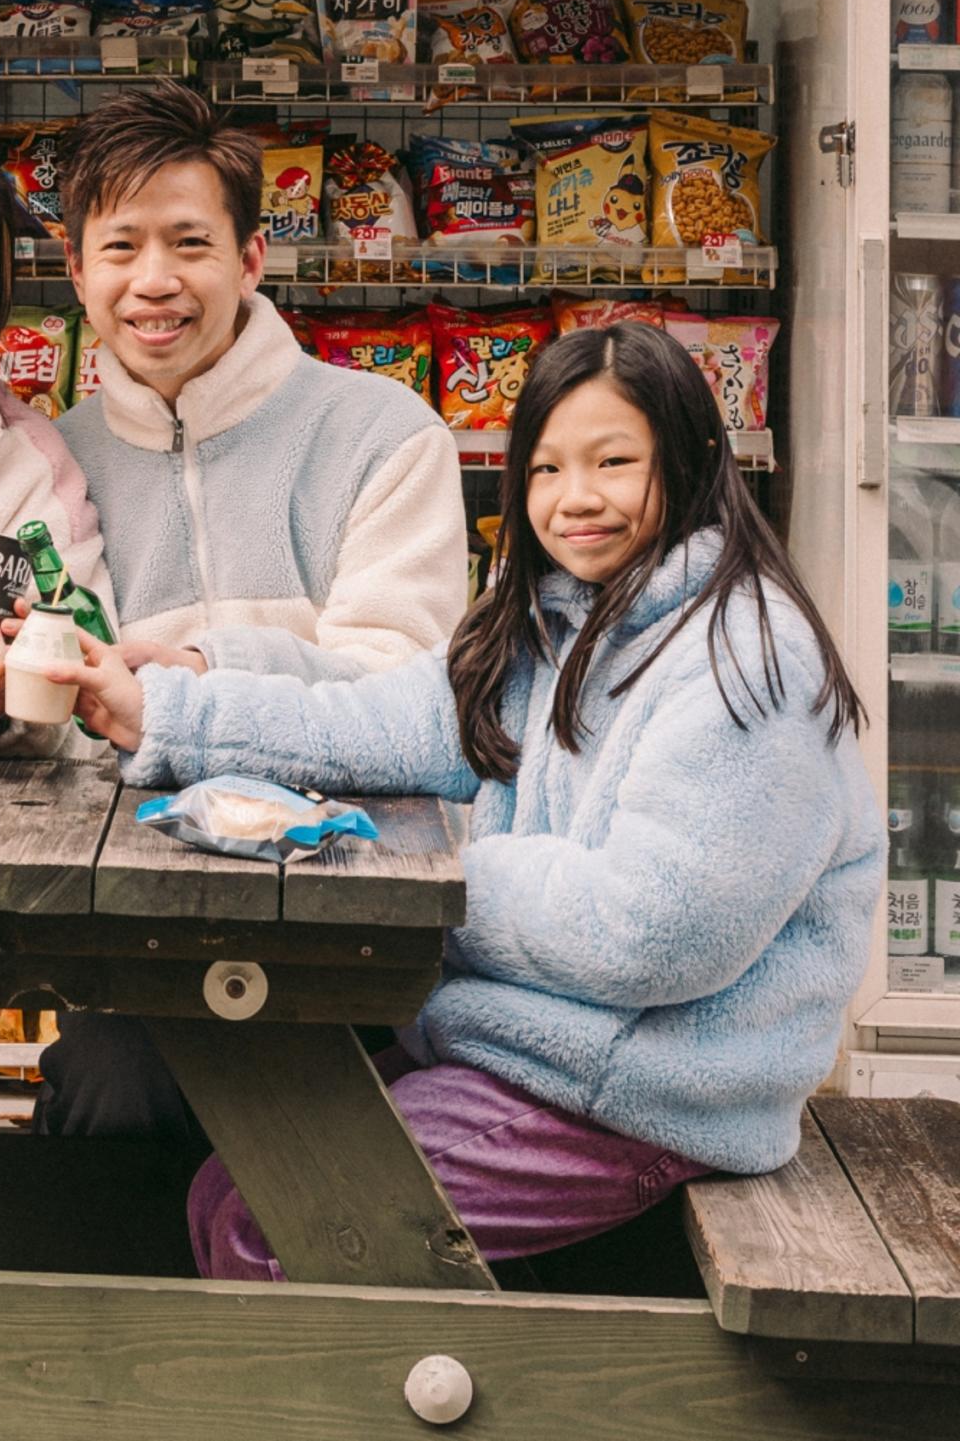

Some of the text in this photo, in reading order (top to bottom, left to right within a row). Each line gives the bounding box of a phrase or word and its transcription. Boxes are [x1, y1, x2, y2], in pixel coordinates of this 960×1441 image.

[900, 1, 935, 16] 1664
[663, 142, 748, 188] 죠리퐁
[439, 166, 493, 182] Giants
[330, 192, 393, 220] 맛동산
[356, 228, 376, 239] 2+1
[704, 236, 724, 246] 2+1
[888, 891, 920, 910] 처음
